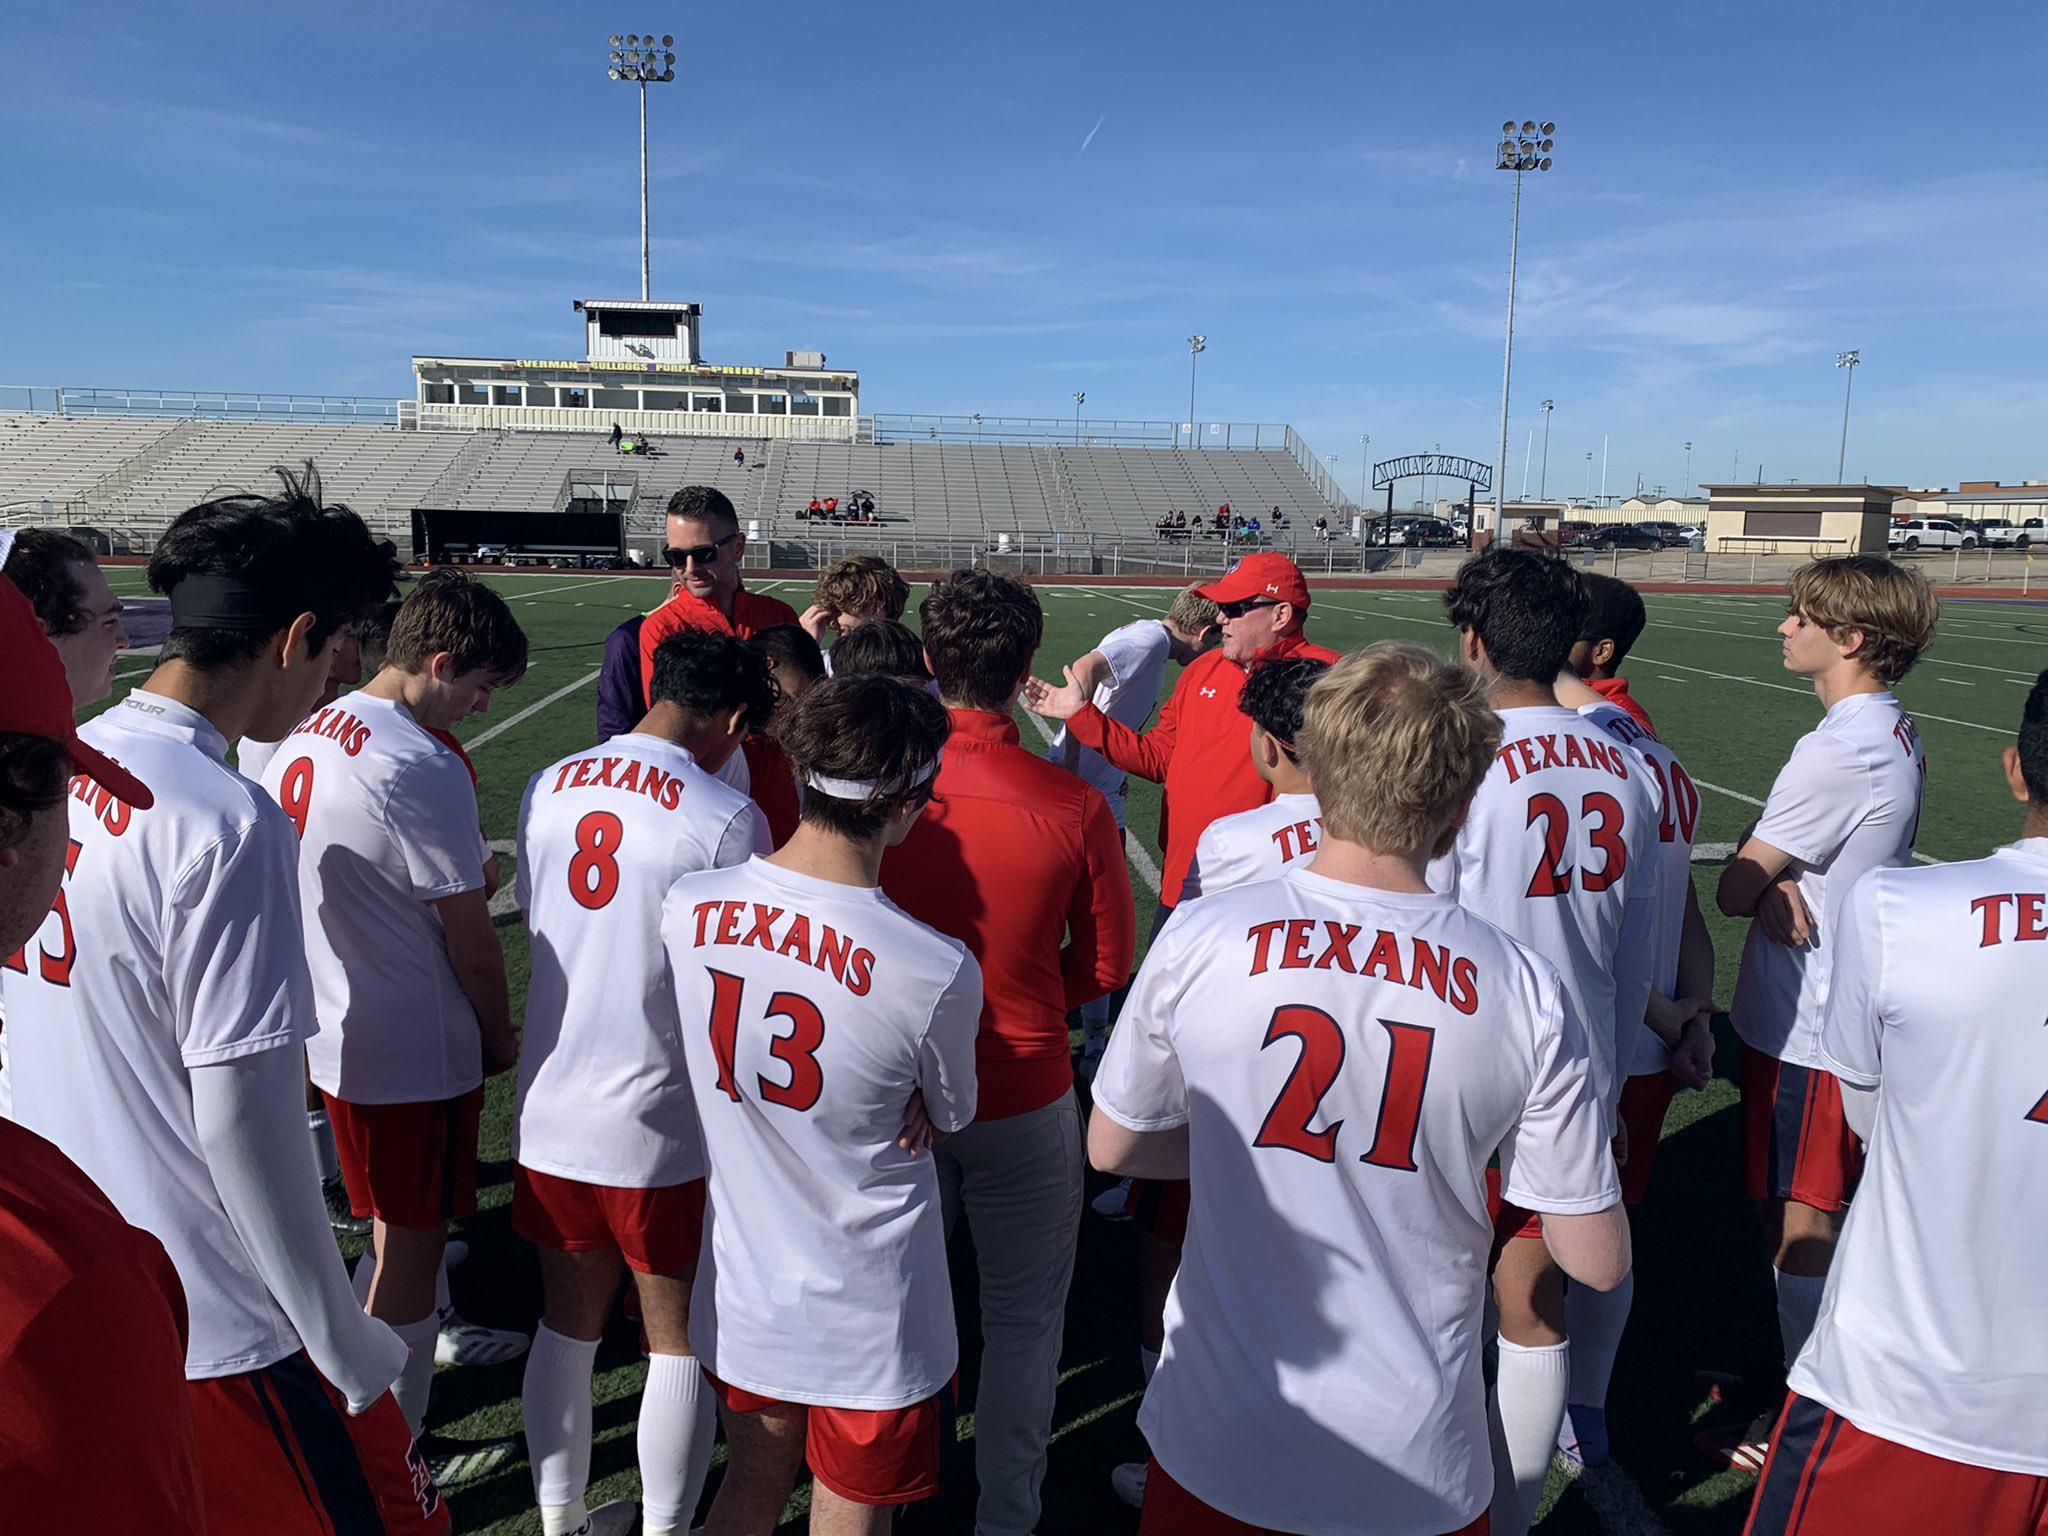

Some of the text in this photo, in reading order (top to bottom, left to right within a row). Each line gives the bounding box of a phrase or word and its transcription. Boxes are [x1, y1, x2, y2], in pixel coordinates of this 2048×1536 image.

[516, 359, 764, 376] EVERMAN BULLDOGS PURPLE PRIDE
[280, 756, 314, 841] 9
[552, 757, 685, 811] TEXANS
[1496, 733, 1629, 785] TEXANS
[567, 810, 624, 911] 8
[1271, 816, 1323, 865] TE
[1524, 791, 1627, 898] 23
[692, 900, 877, 997] TEXANS
[1246, 919, 1479, 1016] TEXANS
[703, 965, 826, 1113] 13
[1252, 1003, 1436, 1173] 21
